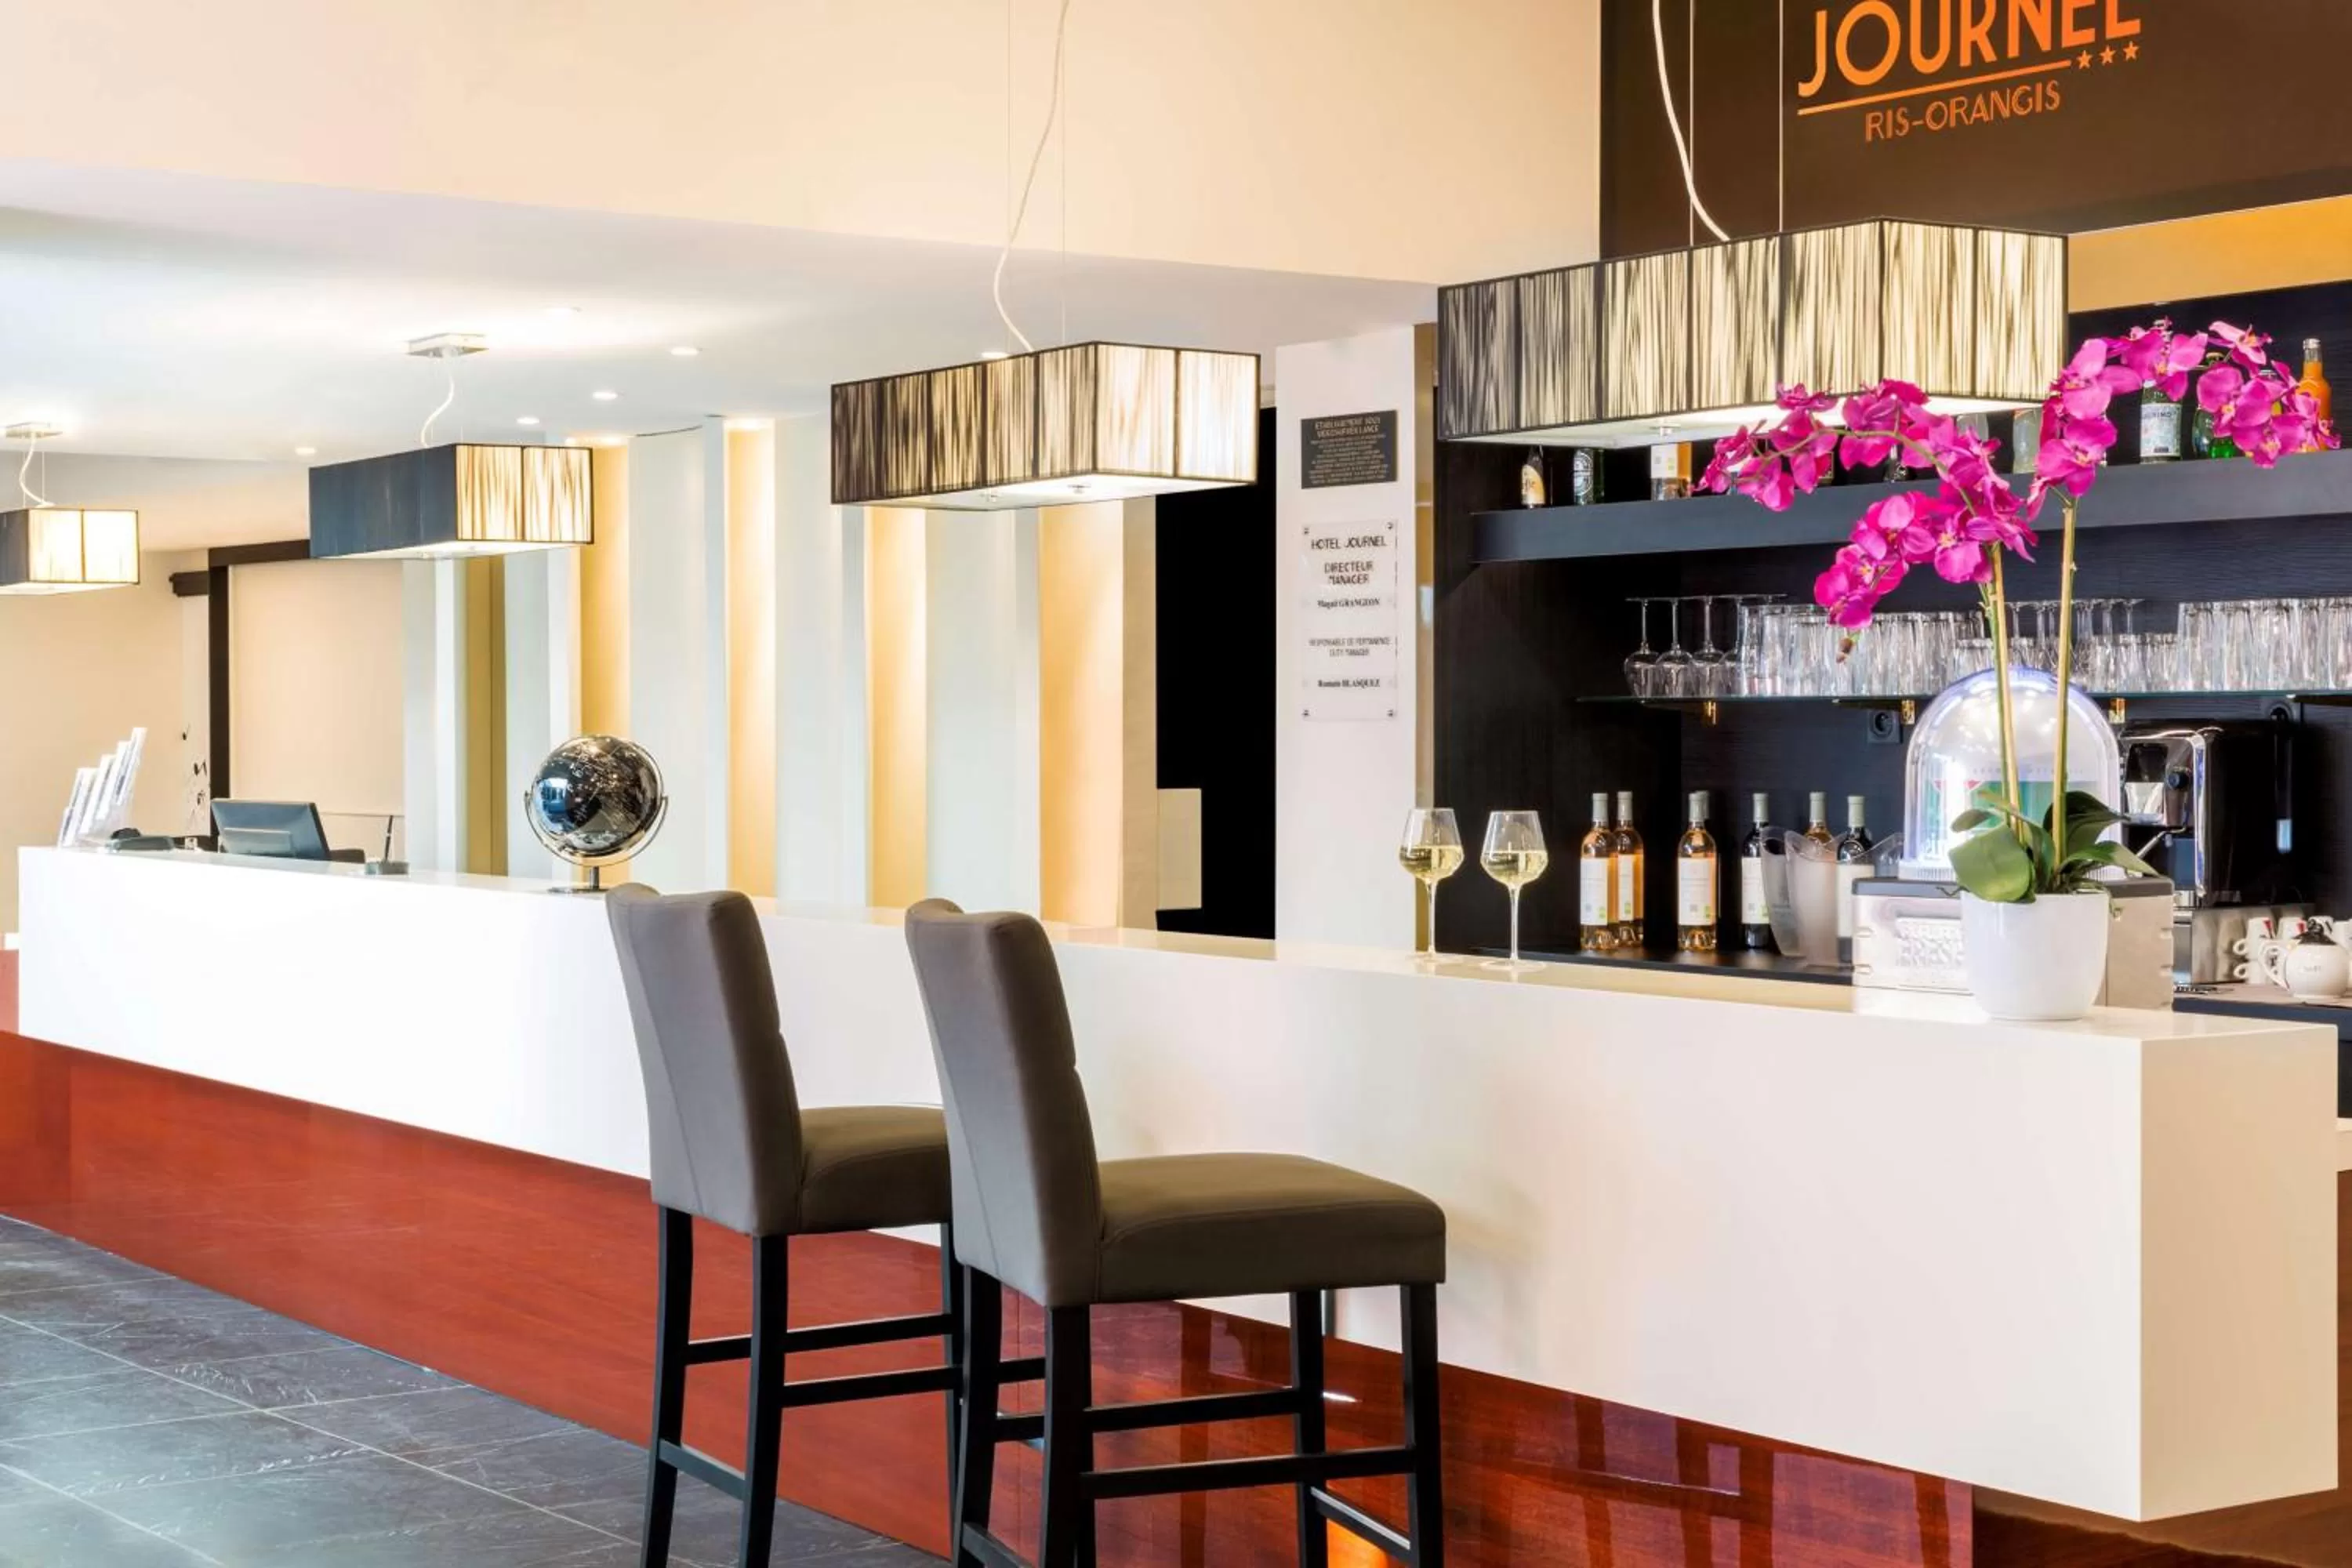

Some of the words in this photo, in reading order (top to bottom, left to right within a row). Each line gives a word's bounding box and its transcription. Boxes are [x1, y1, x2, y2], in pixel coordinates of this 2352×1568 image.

[1864, 79, 2061, 142] RIS-ORANGIS
[1311, 538, 1341, 550] HOTEL
[1344, 535, 1387, 548] JOURNEL
[1324, 561, 1374, 573] DIRECTEUR
[1329, 573, 1370, 585] MANAGER
